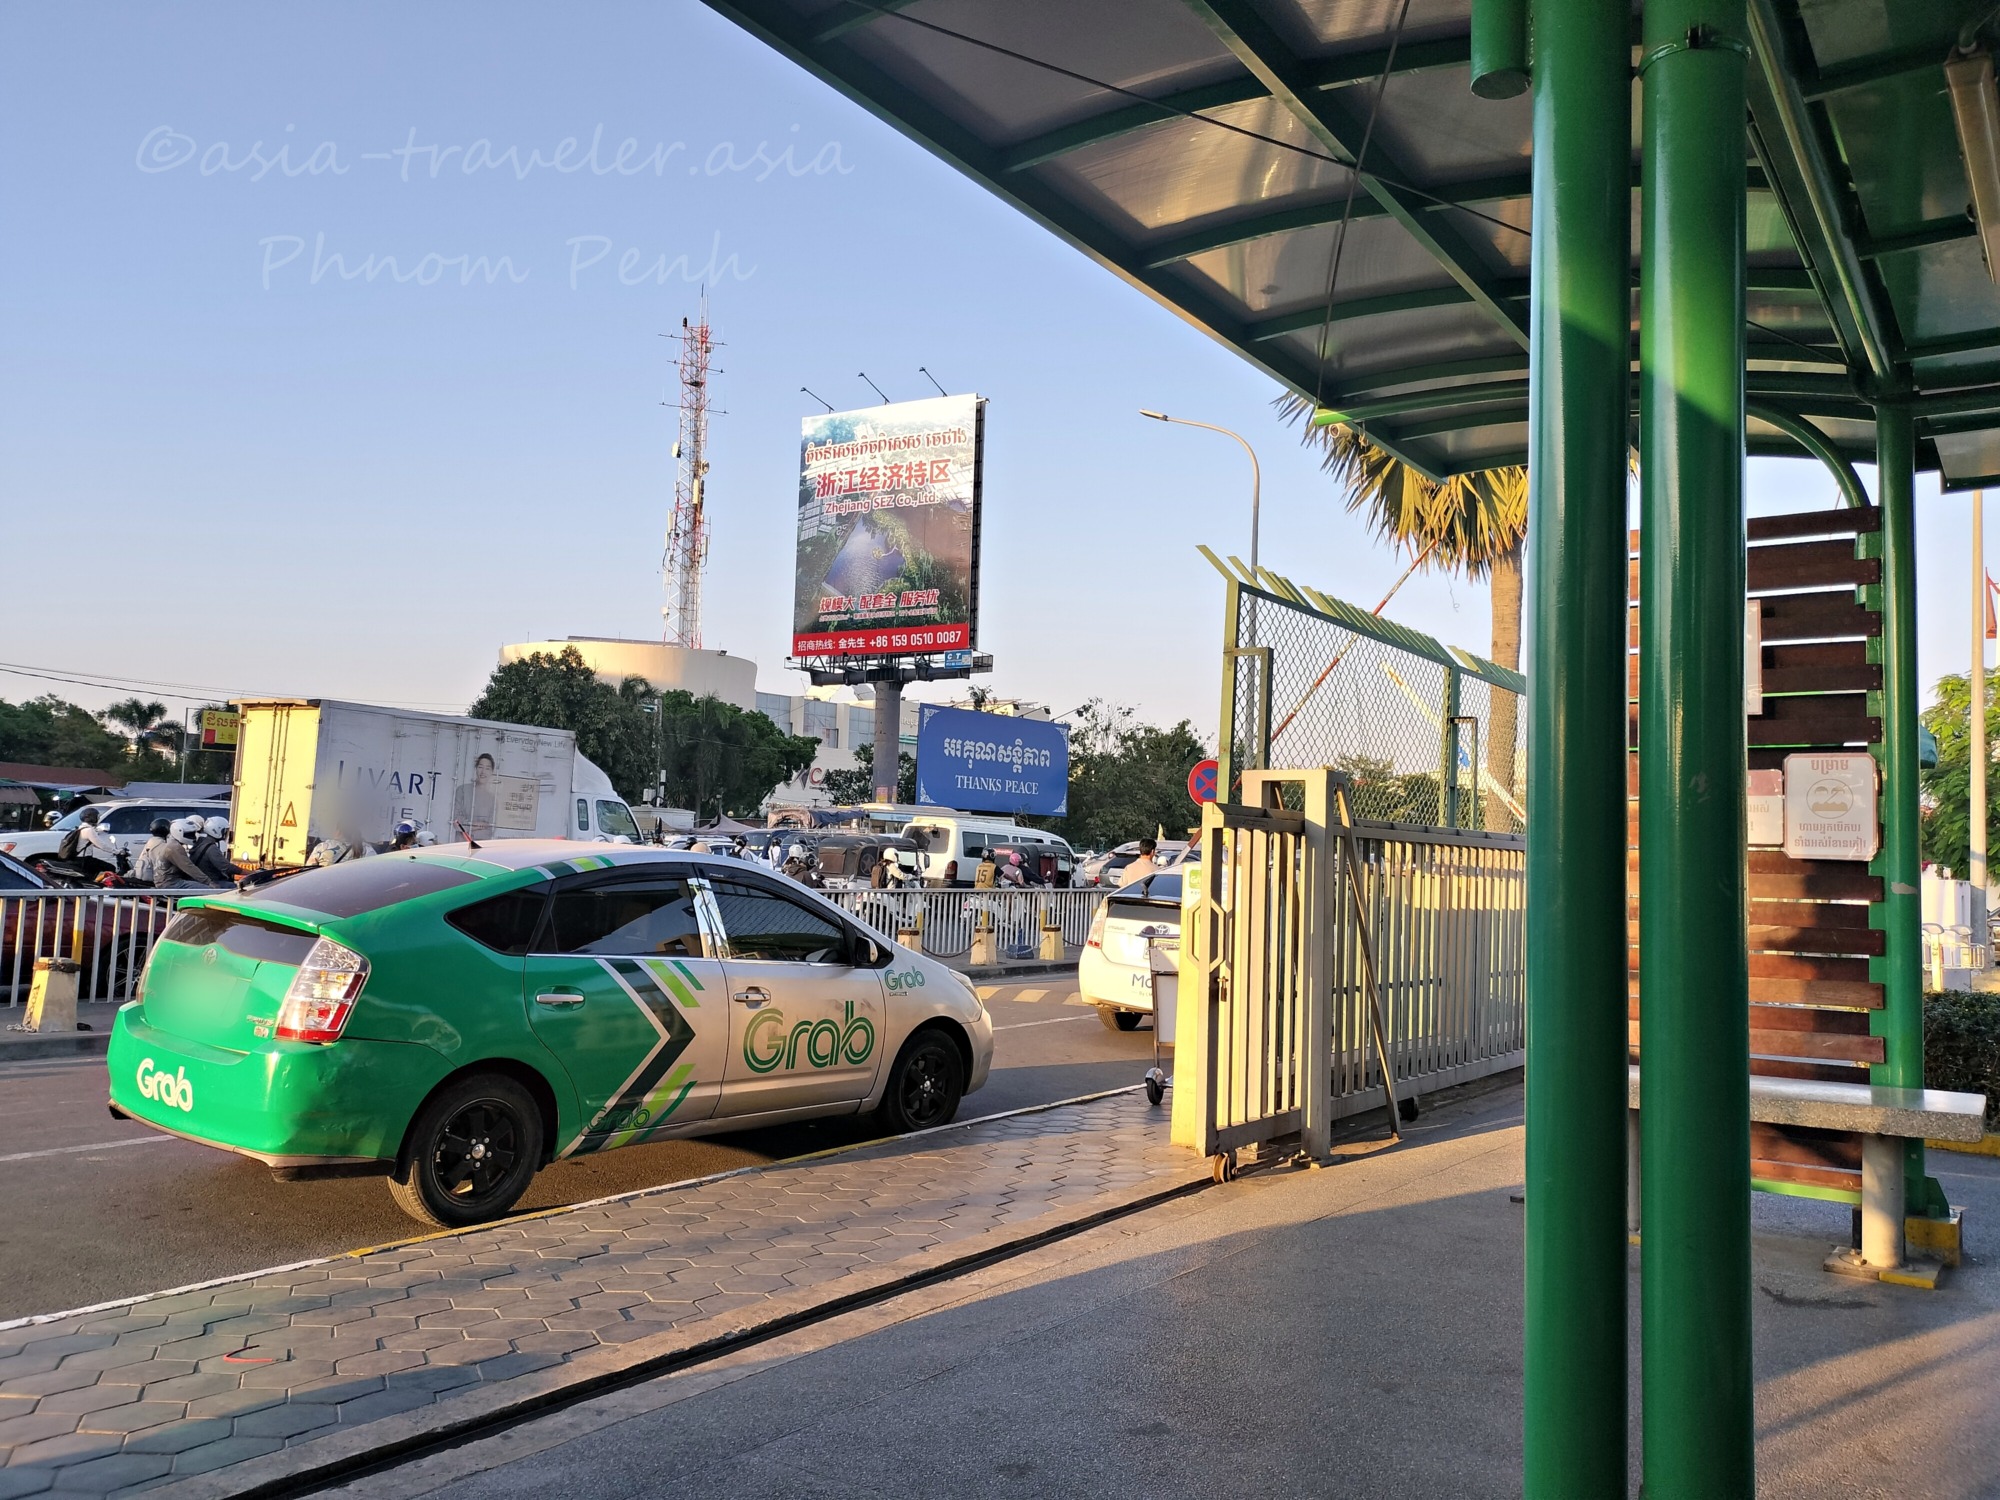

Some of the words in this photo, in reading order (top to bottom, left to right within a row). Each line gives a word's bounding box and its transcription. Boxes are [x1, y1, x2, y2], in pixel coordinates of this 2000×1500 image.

[816, 459, 951, 498] 浙江经济特区
[825, 499, 870, 515] Zhejiang
[873, 496, 894, 509] SEZ
[896, 492, 940, 507] Co.,Ltd.
[818, 596, 856, 613] 规模大
[859, 593, 897, 611] 配套全
[900, 589, 940, 607] 服务优
[838, 637, 866, 649] 金先生
[869, 635, 888, 648] +86
[891, 634, 908, 647] 159
[910, 632, 934, 646] 0510
[936, 630, 962, 644] 0087
[943, 737, 1051, 774] អរគុណសន្តិភាព
[955, 774, 1002, 792] THANKS
[1005, 779, 1039, 795] PEACE
[976, 869, 989, 884] 15
[884, 965, 926, 991] Grab
[743, 1000, 876, 1074] Grab
[136, 1057, 194, 1113] Grab
[587, 1102, 651, 1132] Grab
